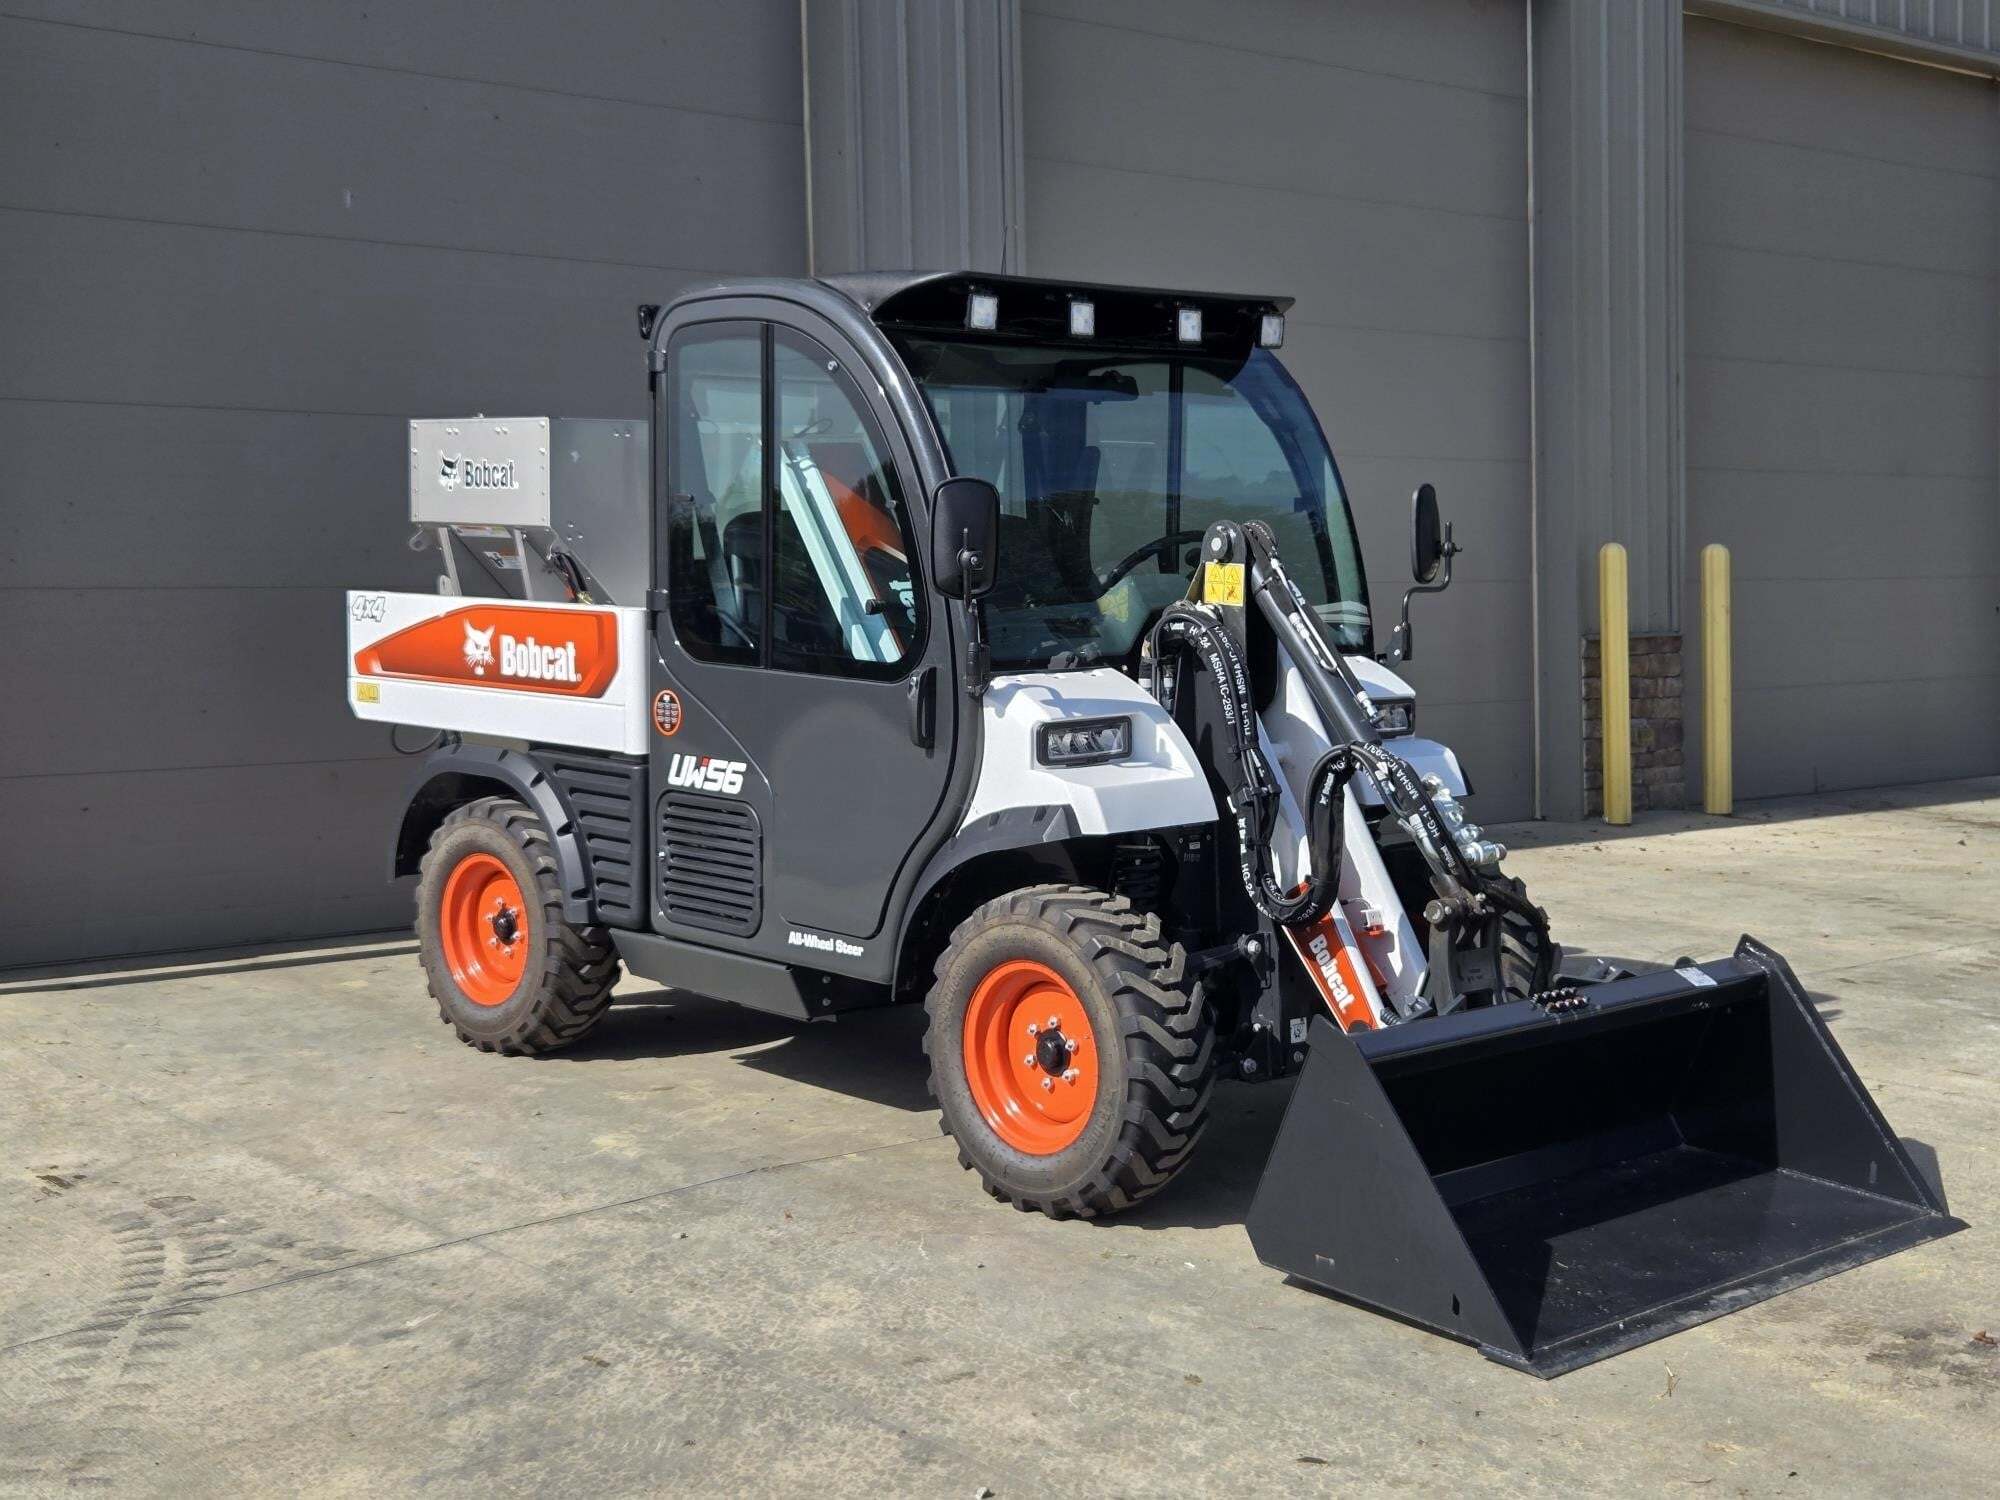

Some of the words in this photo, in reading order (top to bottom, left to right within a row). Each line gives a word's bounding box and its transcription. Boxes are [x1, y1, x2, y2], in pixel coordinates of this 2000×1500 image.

[464, 459, 515, 489] Bobcat
[352, 595, 386, 622] 4x4
[499, 634, 577, 682] Bobcat
[1209, 652, 1225, 684] MSHA
[788, 931, 834, 952] All-Wheel
[835, 939, 865, 957] Steer
[1309, 933, 1355, 1010] Bobcat
